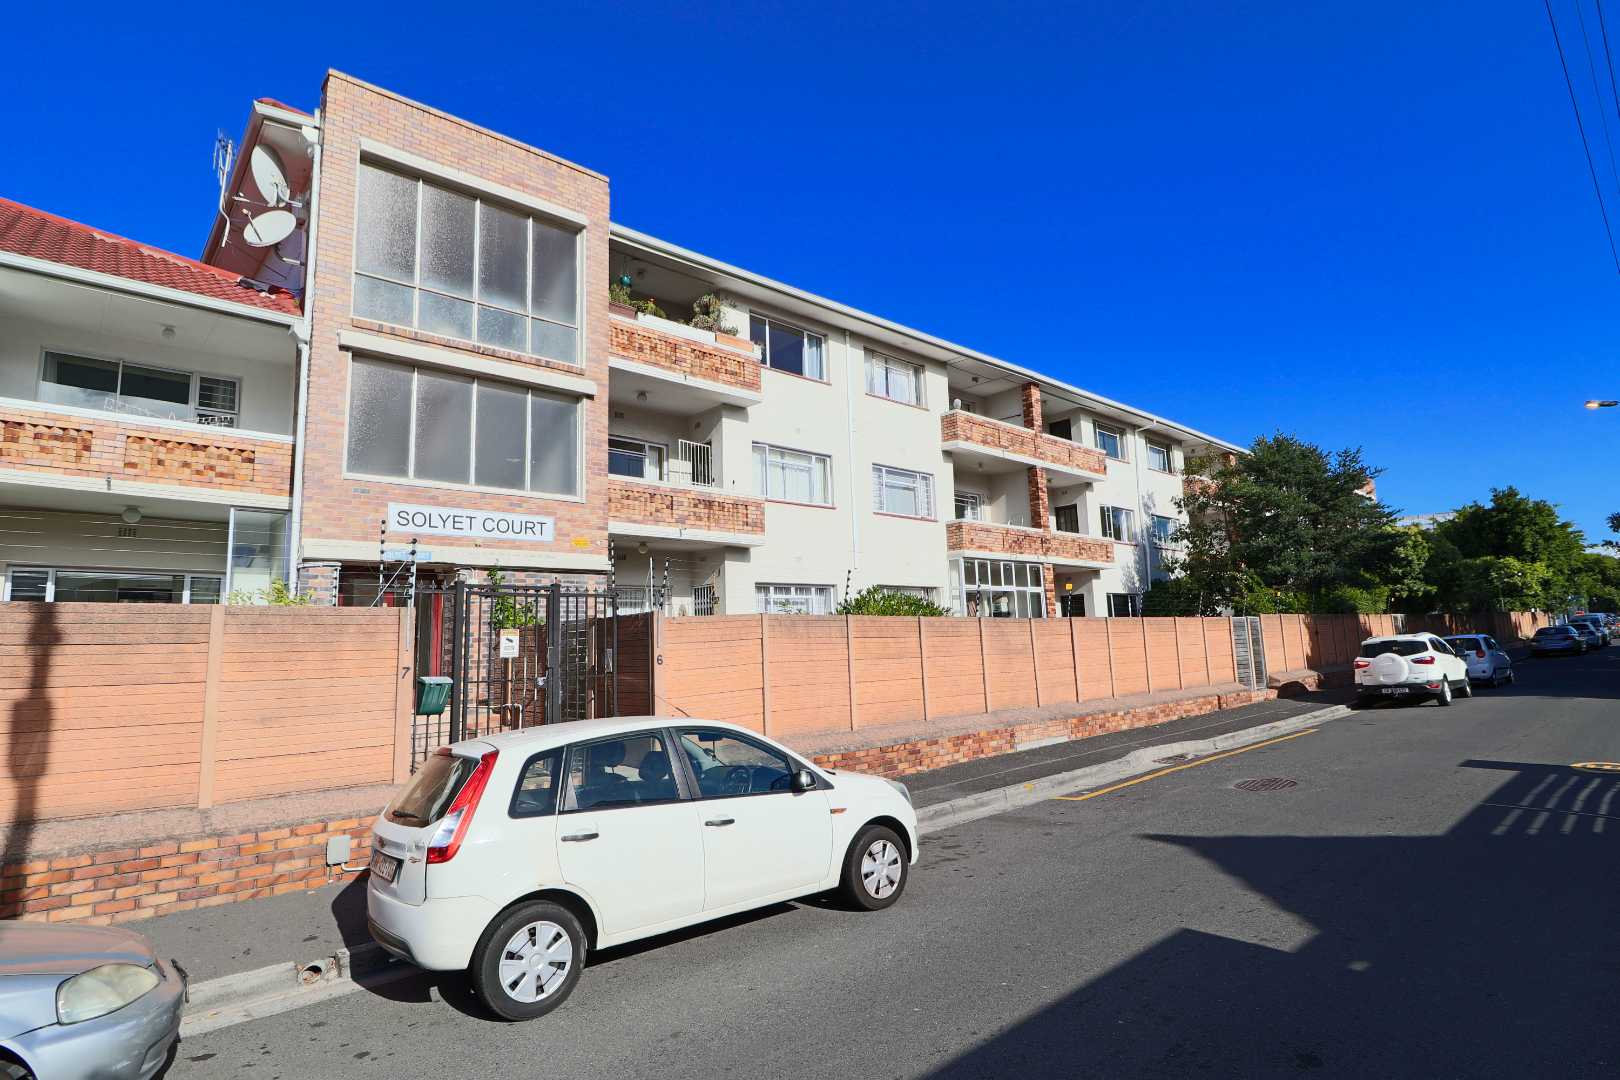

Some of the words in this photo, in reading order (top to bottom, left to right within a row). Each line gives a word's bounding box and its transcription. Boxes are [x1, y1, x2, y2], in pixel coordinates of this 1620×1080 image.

[396, 510, 477, 531] SOLYET
[482, 517, 547, 536] COURT
[656, 654, 664, 666] 6
[401, 666, 410, 679] 7
